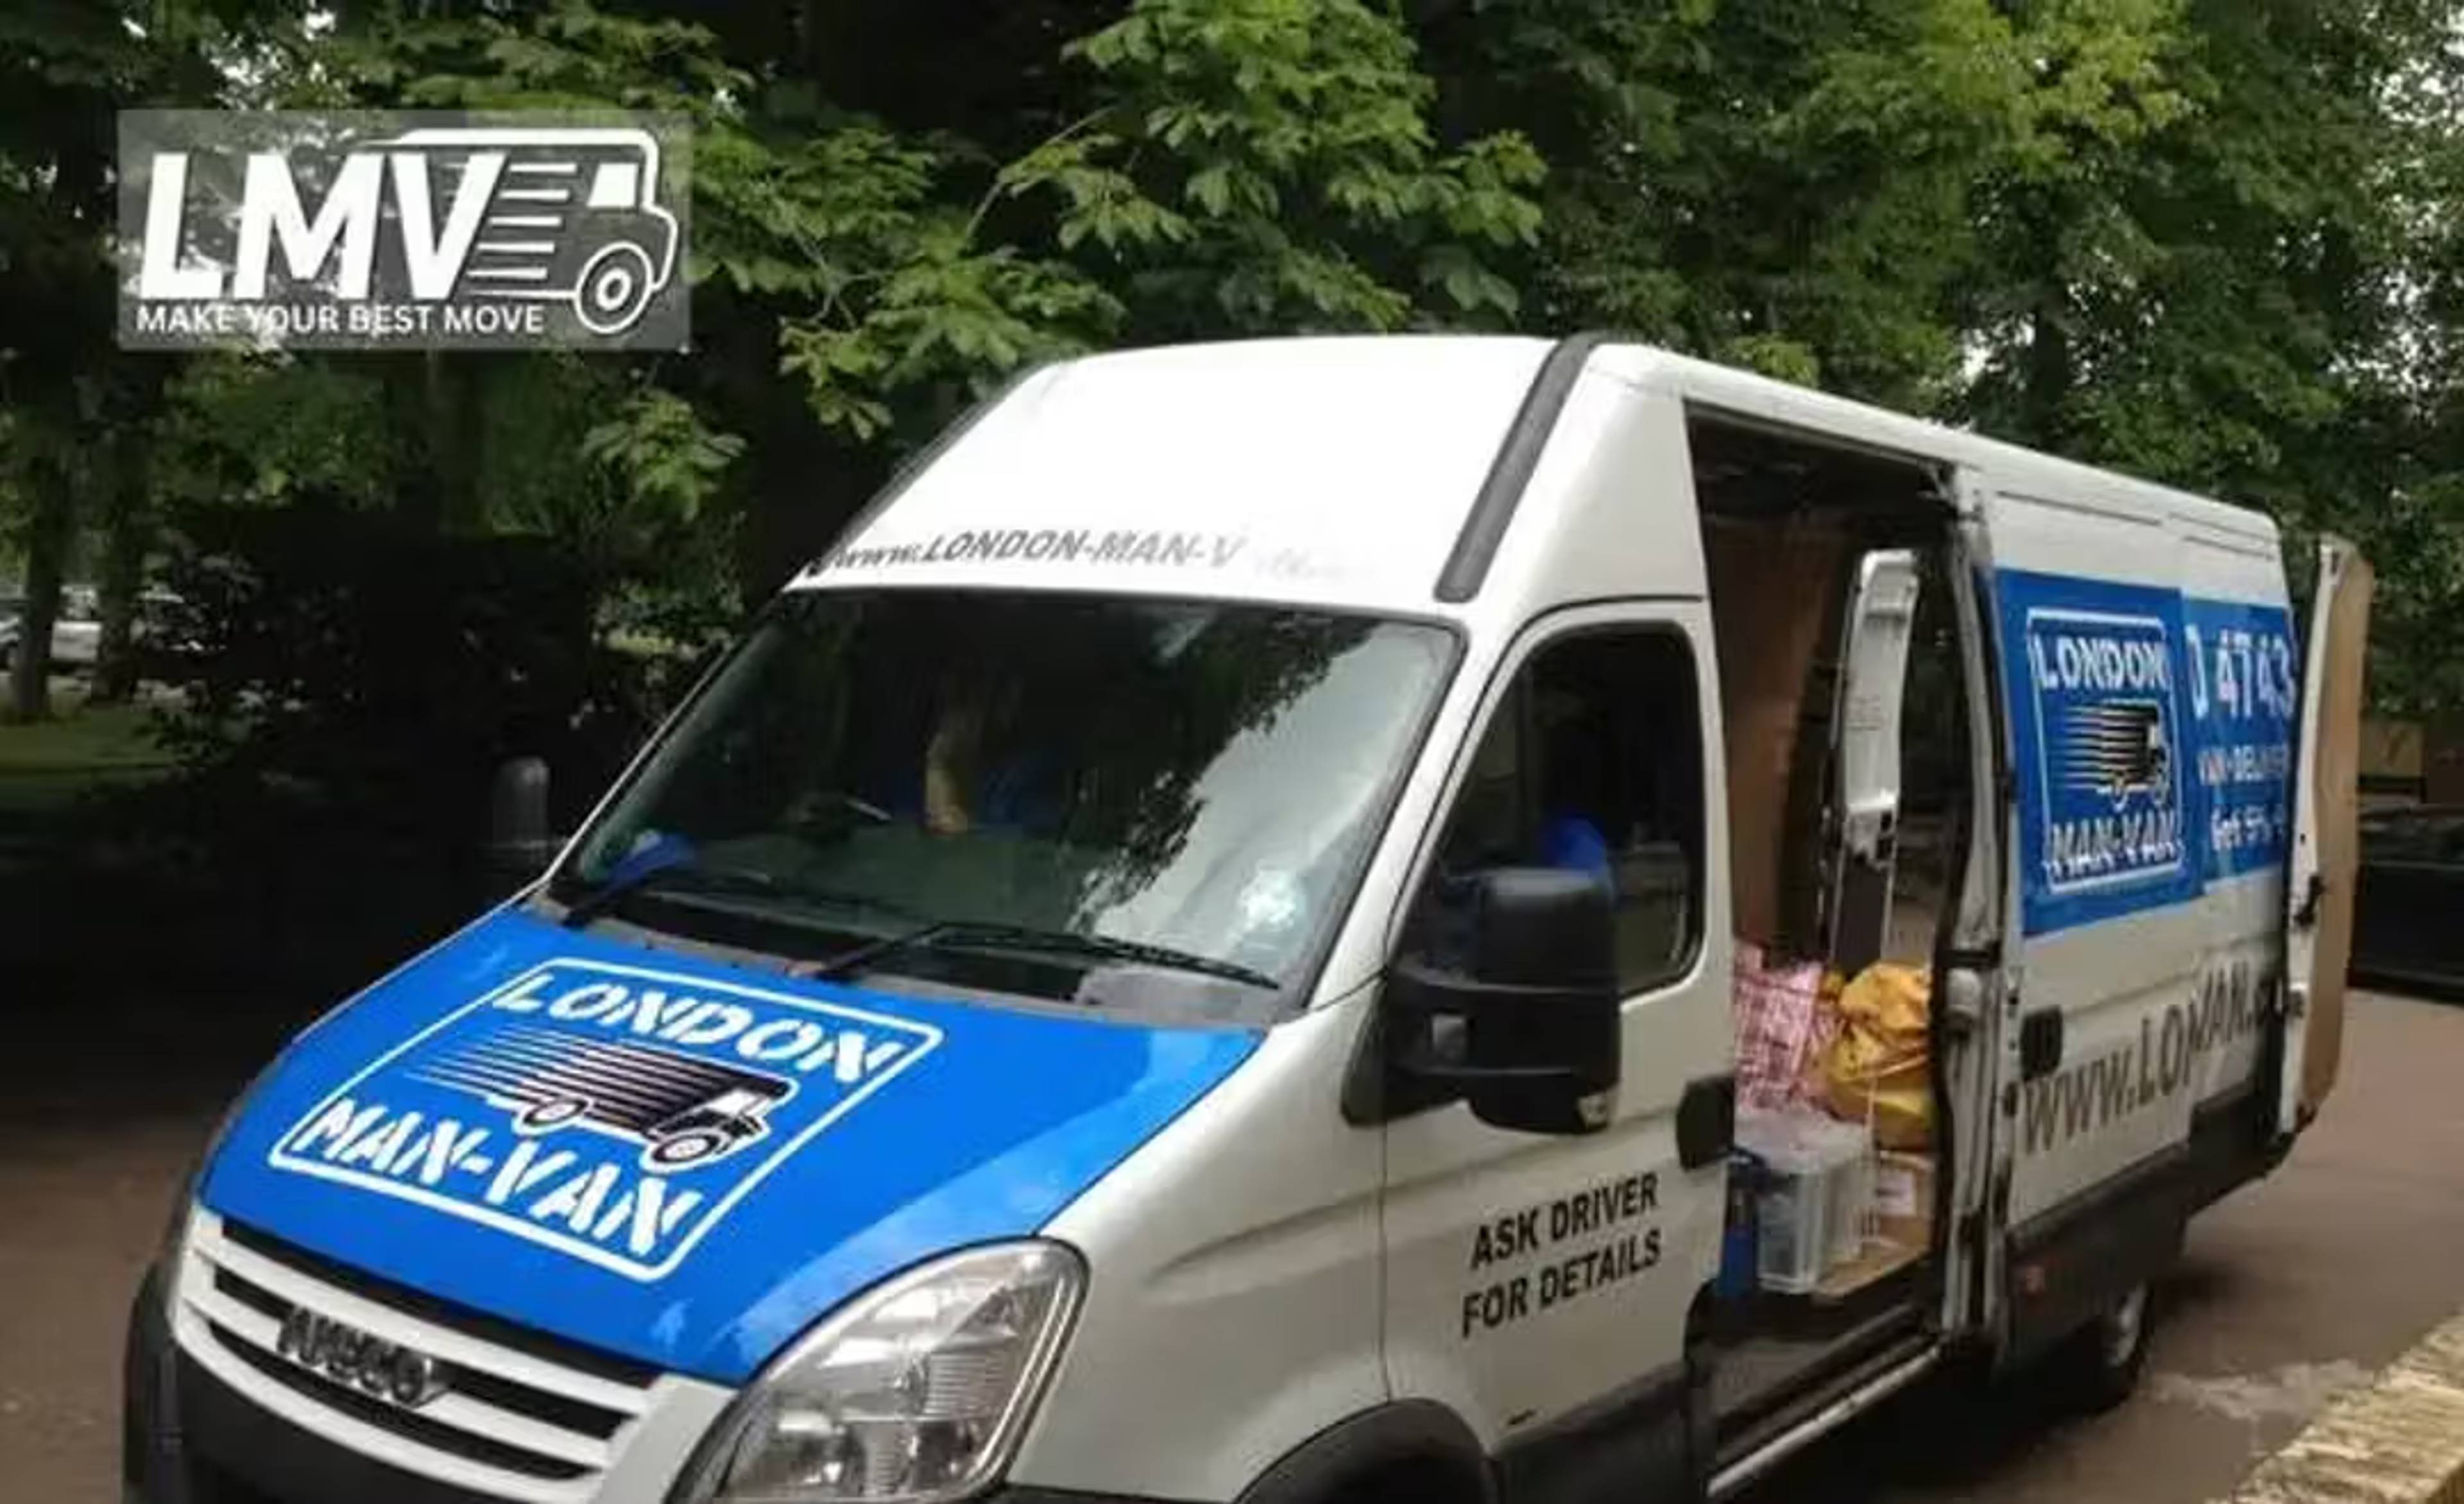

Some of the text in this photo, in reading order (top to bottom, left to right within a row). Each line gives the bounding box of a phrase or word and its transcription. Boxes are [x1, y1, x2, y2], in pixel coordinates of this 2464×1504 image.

[2032, 634, 2173, 690] LONDON
[492, 972, 905, 1082] LONDON
[290, 1098, 703, 1254] MAN-VAN
[1470, 1172, 1658, 1270] ASK DRIVER
[1461, 1228, 1661, 1338] FOR DETAILS
